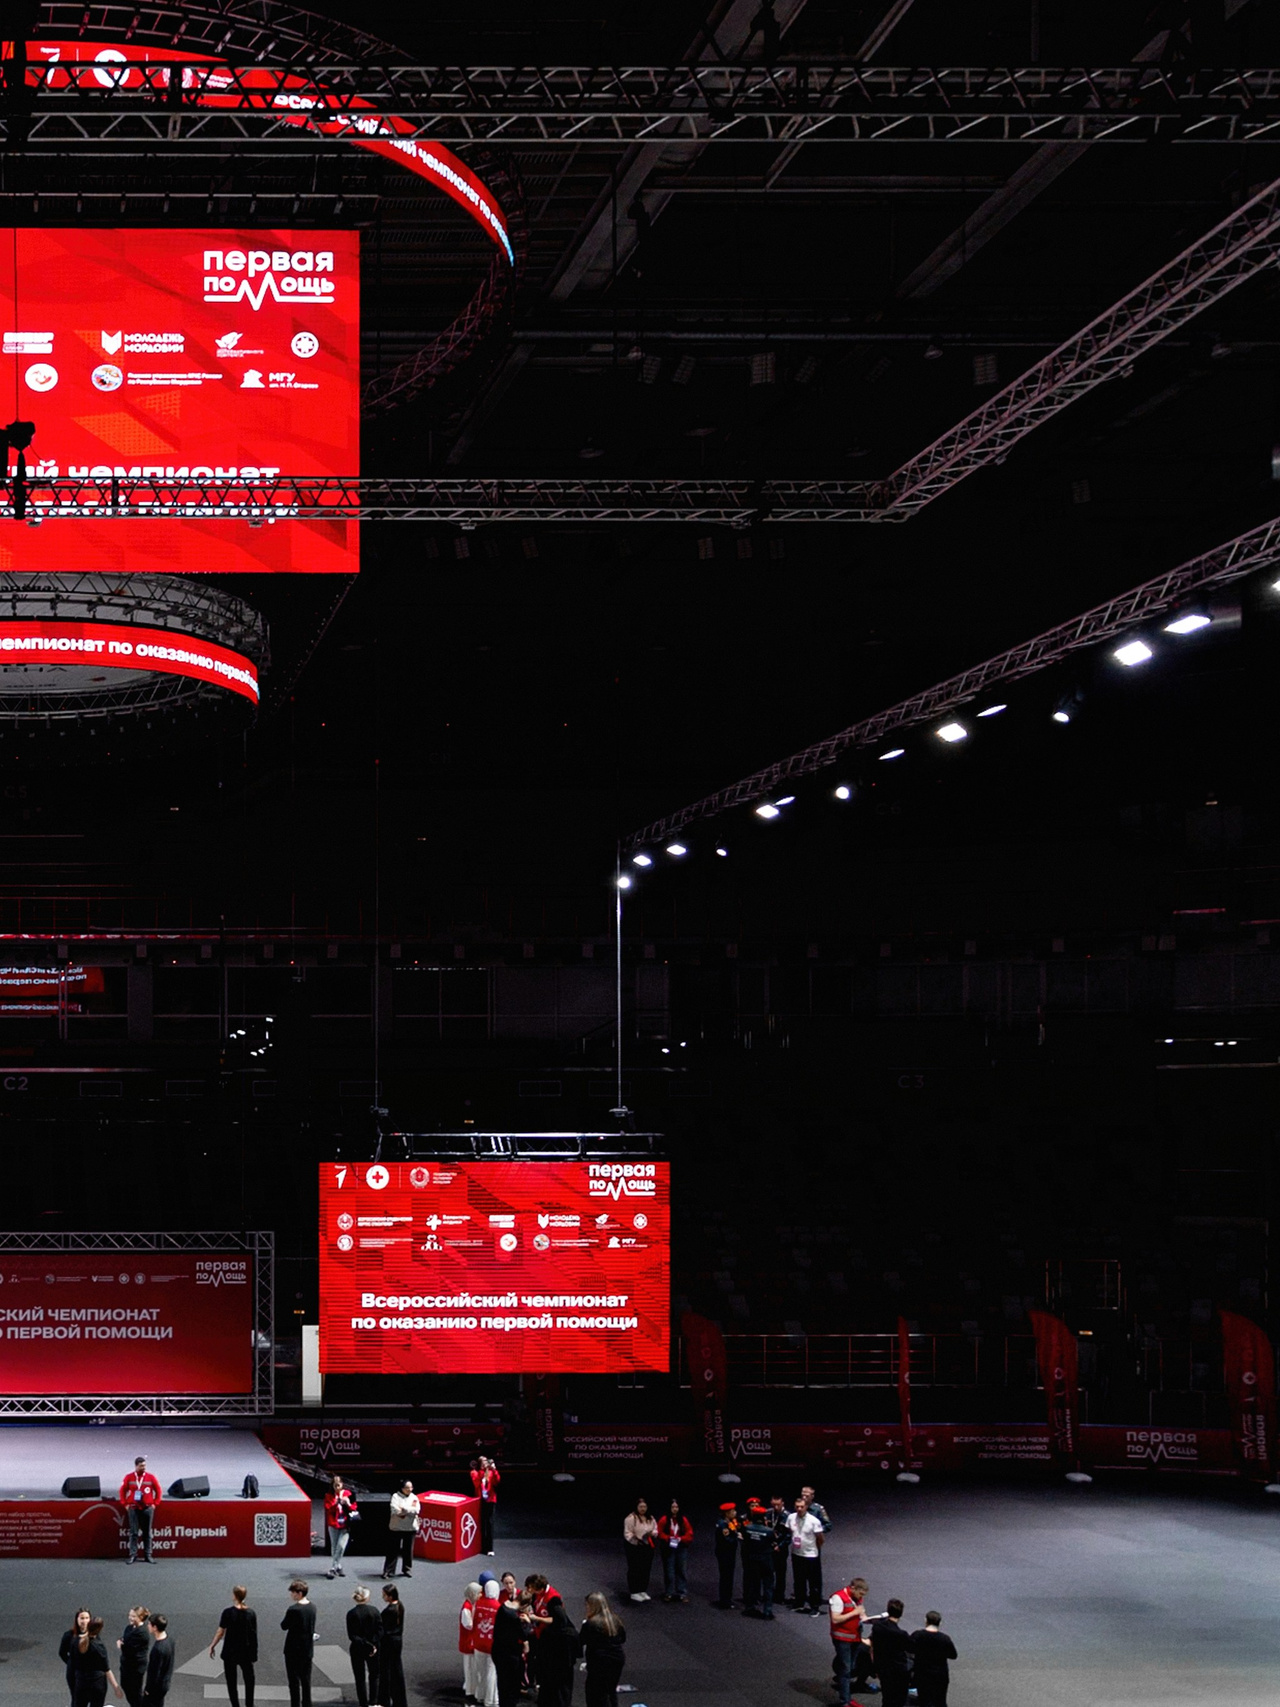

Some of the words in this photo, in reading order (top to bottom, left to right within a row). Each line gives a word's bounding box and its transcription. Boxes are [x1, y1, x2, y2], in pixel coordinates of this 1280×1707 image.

[203, 250, 334, 278] первая
[124, 343, 184, 353] МОРДОВИИ
[269, 372, 295, 382] МГУ
[108, 640, 133, 655] по
[135, 643, 214, 670] оказанию
[589, 1163, 656, 1180] первая
[196, 1261, 247, 1273] первая
[361, 1292, 518, 1311] Всероссийский
[521, 1295, 628, 1309] чемпионат
[47, 1308, 160, 1321] ЧЕМПИОНАТ
[351, 1316, 377, 1330] по
[378, 1316, 478, 1330] оказанию
[480, 1313, 553, 1333] первой
[556, 1316, 638, 1331] помощи
[6, 1323, 81, 1340] ПЕРВОЙ
[84, 1326, 173, 1341] ПОМОЩИ
[300, 1429, 361, 1442] первая
[1126, 1431, 1198, 1445] первая
[175, 1525, 227, 1539] Первый
